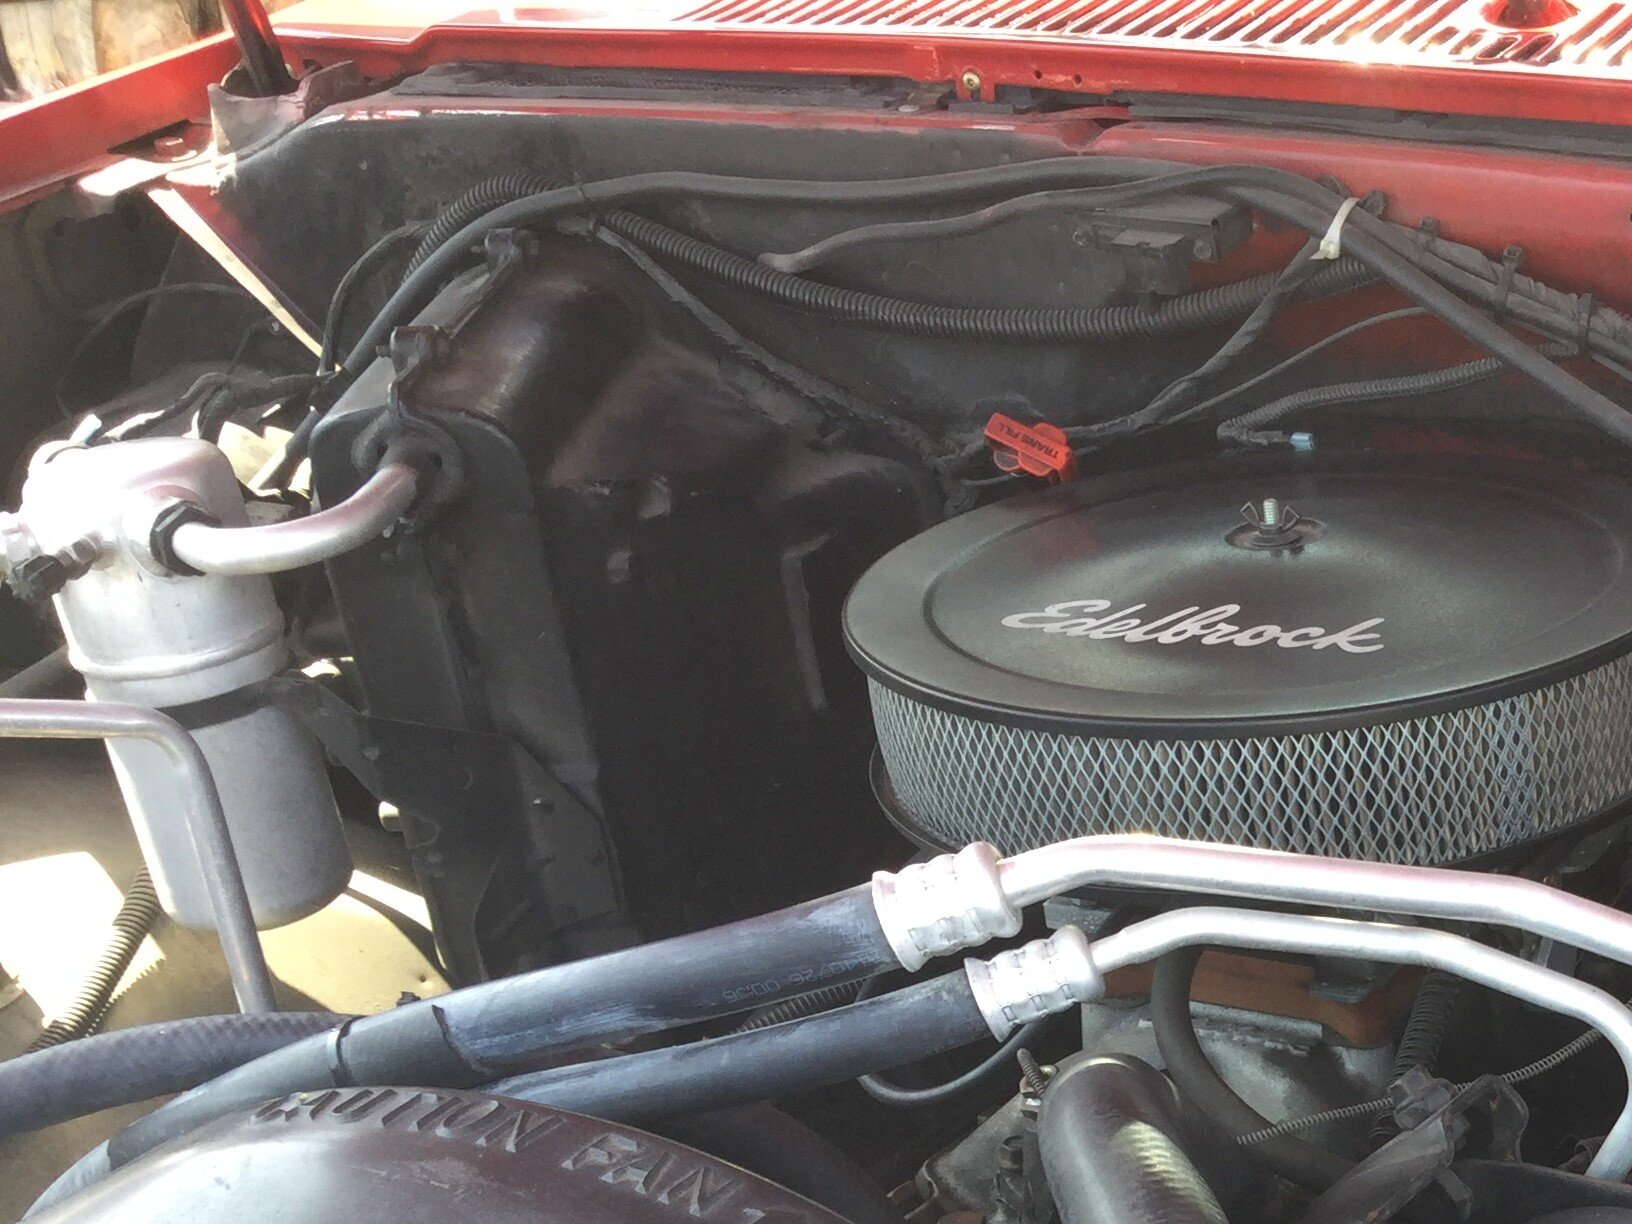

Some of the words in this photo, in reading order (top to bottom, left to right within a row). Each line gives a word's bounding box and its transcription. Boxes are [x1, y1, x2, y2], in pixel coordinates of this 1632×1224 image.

[1020, 435, 1059, 459] TRANS
[1000, 599, 1386, 654] Edelbrock
[252, 1089, 566, 1153] CAUTION
[561, 1133, 741, 1217] FAN
